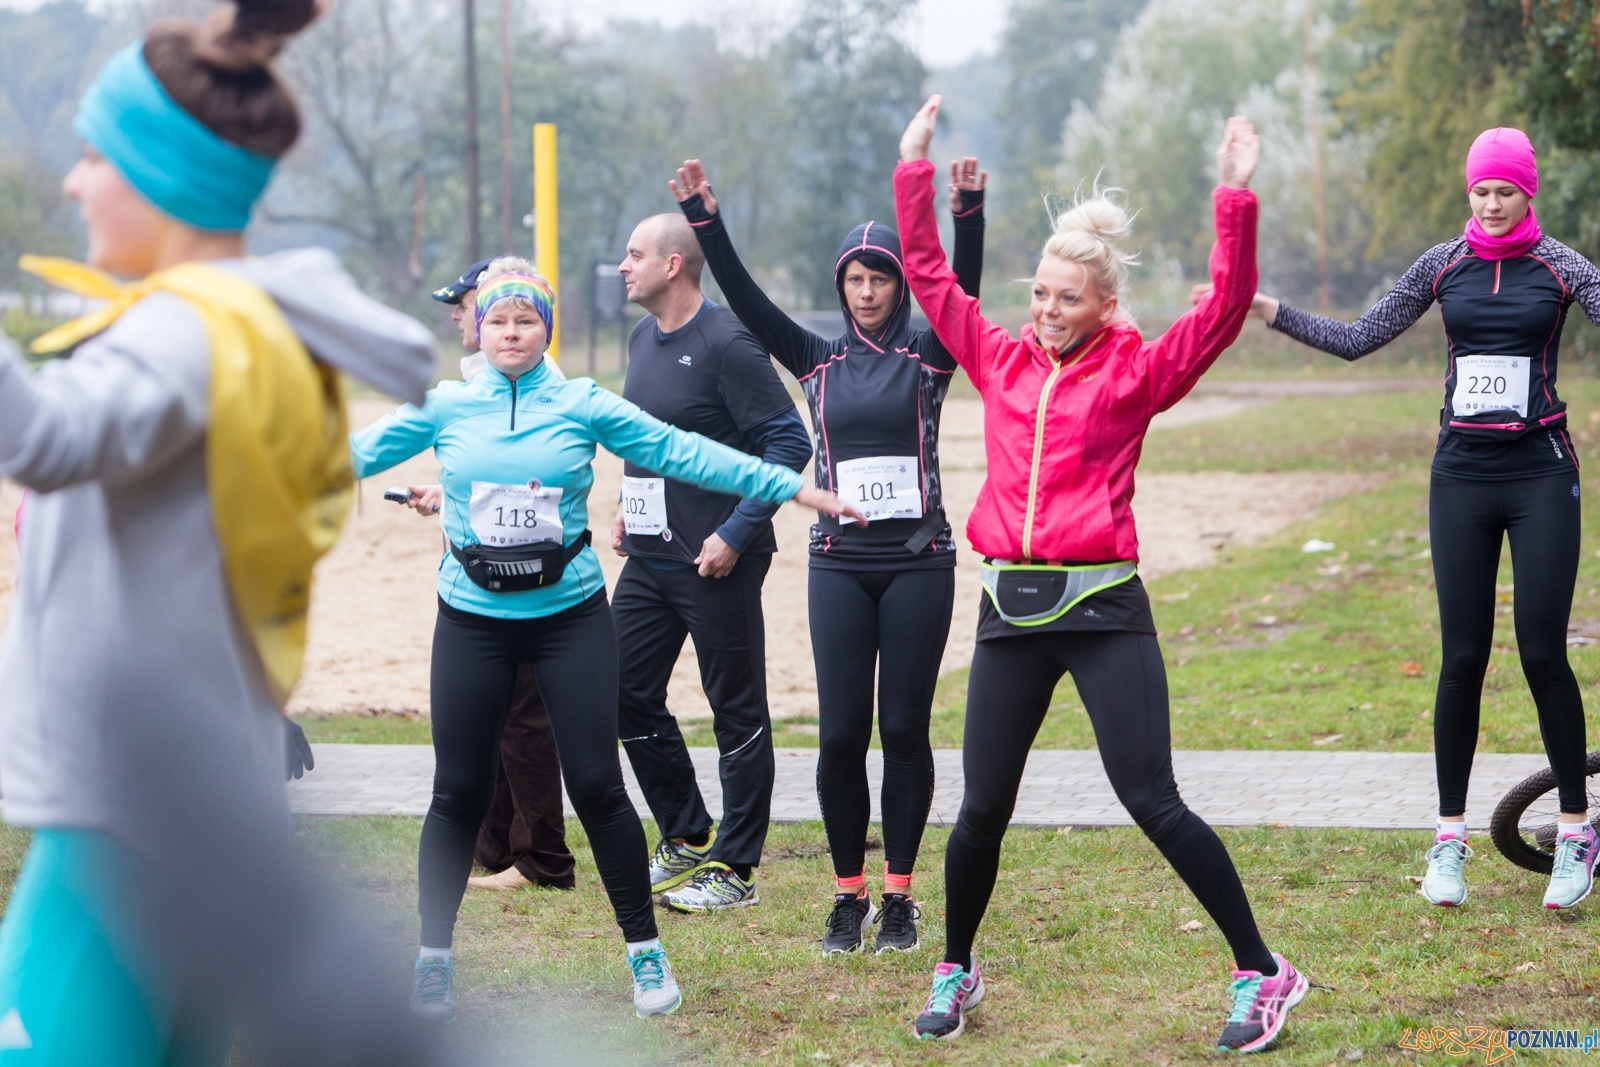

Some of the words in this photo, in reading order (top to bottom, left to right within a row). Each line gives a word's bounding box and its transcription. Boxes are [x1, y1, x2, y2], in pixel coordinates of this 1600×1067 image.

[1468, 376, 1507, 395] 220
[858, 482, 897, 502] 101
[625, 497, 647, 515] 102
[494, 506, 537, 529] 118
